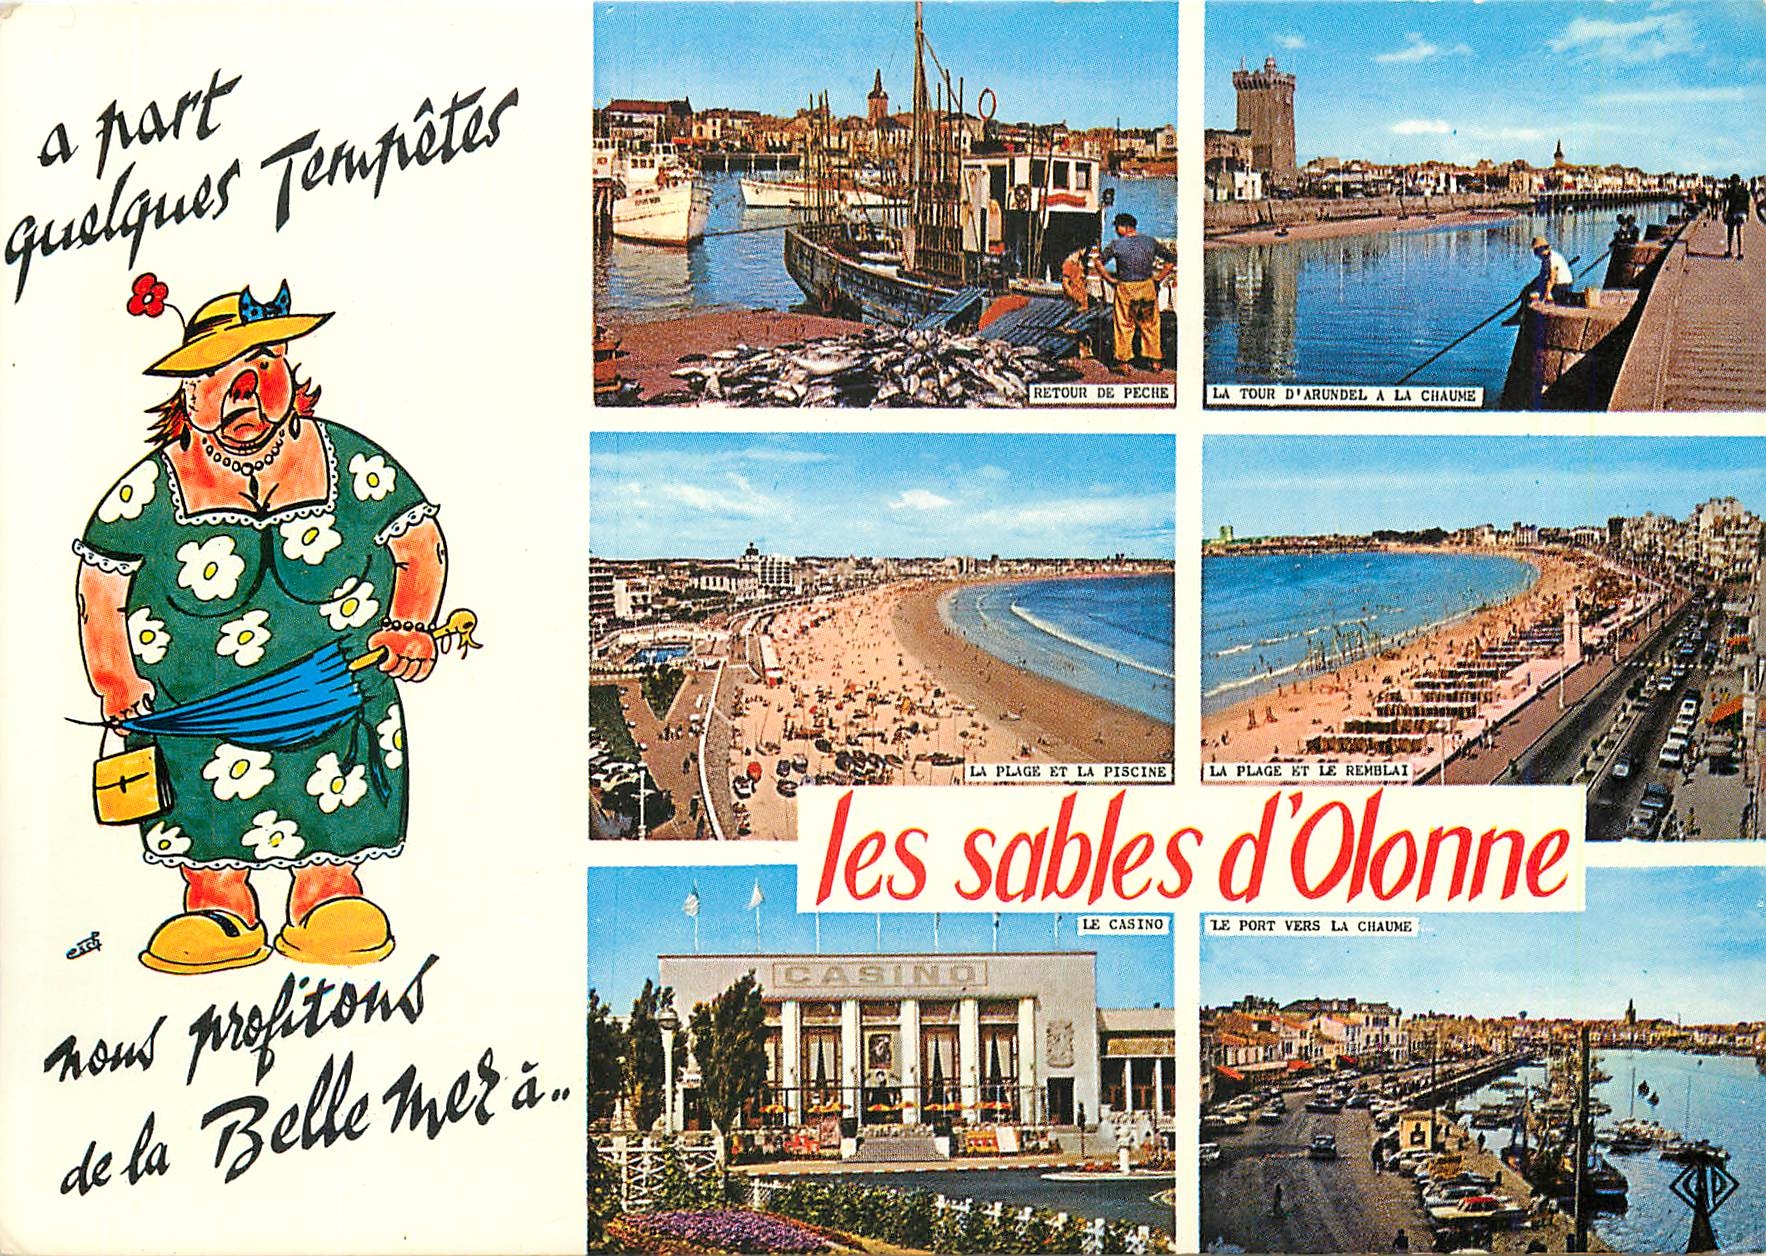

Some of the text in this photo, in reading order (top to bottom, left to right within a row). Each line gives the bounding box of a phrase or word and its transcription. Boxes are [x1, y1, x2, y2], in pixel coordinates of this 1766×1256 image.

[38, 69, 242, 179] a part
[5, 87, 518, 303] quelques Tempêtes
[44, 954, 439, 1086] nous profitons
[785, 965, 976, 985] CASINO
[61, 1141, 112, 1196] de
[121, 1112, 169, 1185] la
[201, 1051, 369, 1184] Belle
